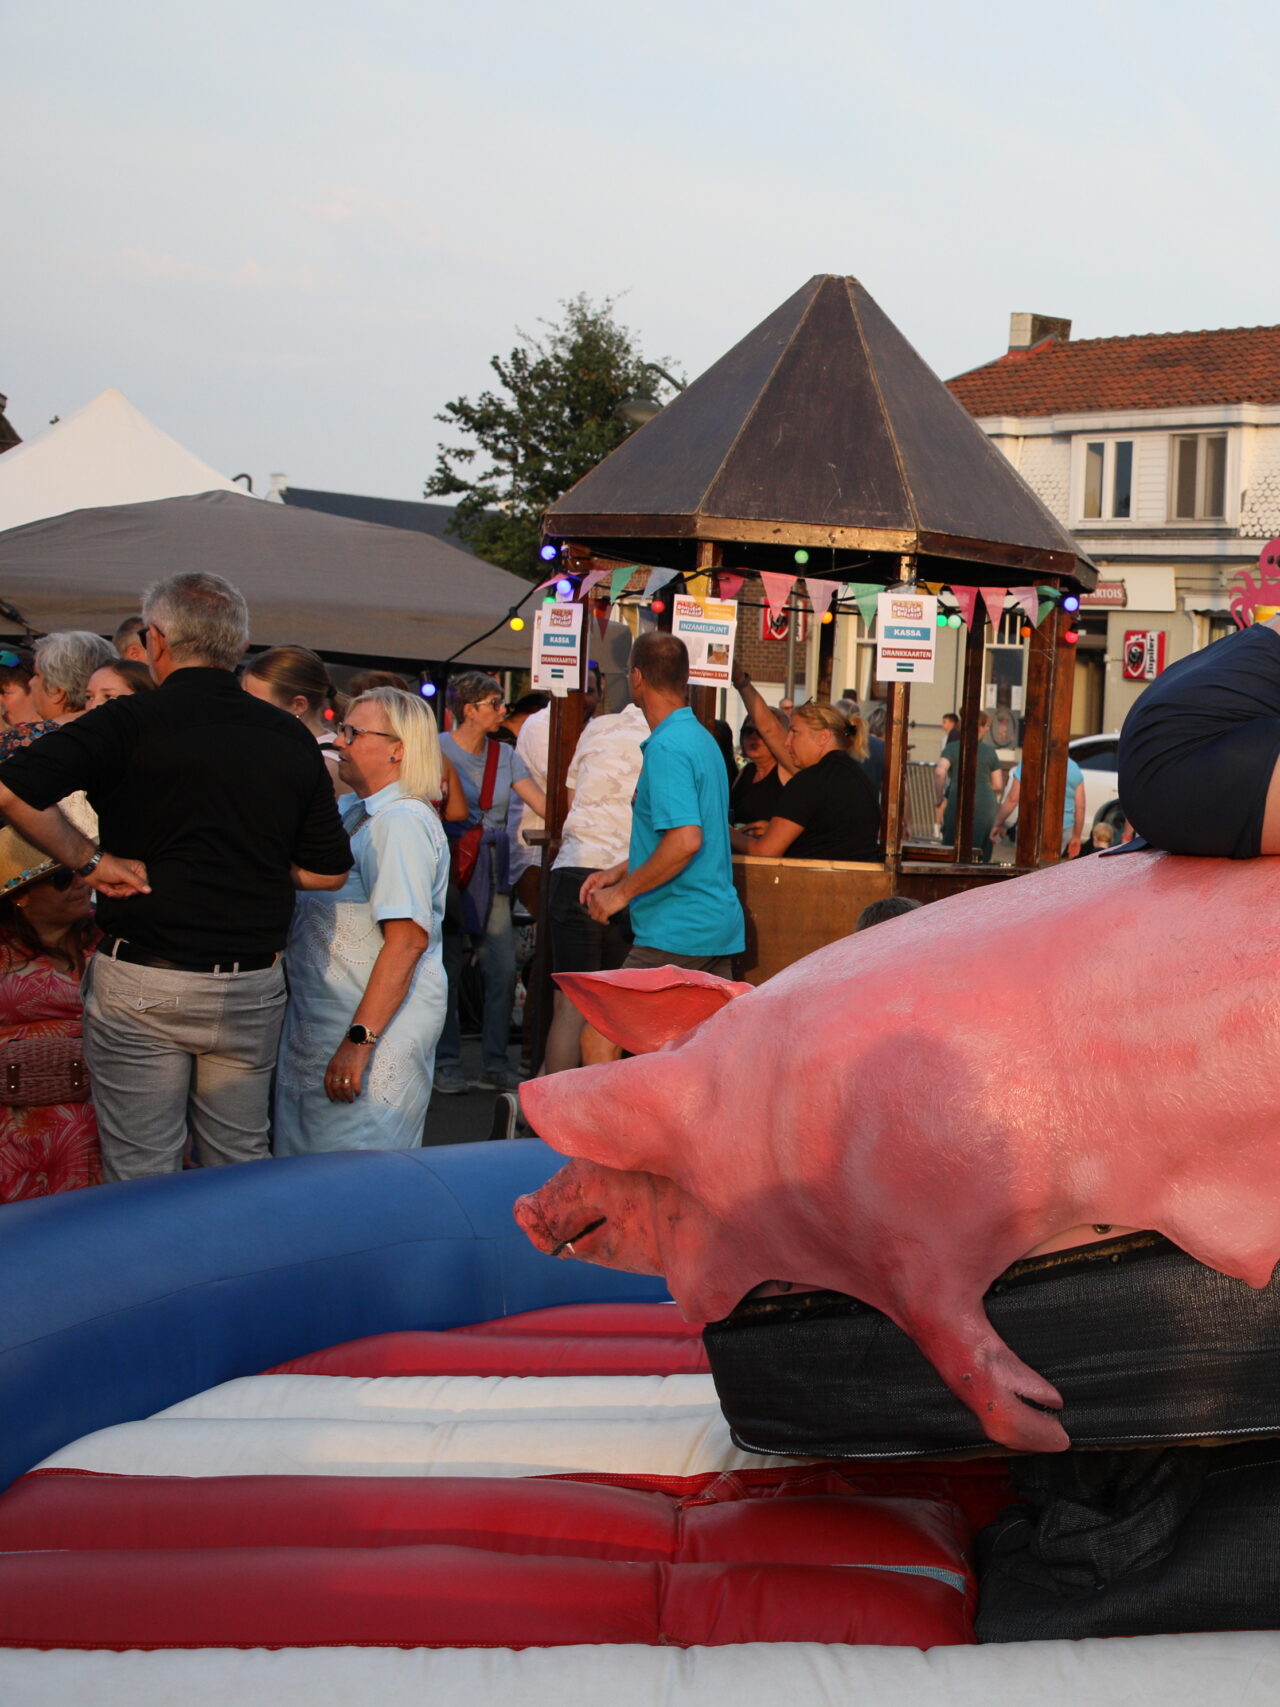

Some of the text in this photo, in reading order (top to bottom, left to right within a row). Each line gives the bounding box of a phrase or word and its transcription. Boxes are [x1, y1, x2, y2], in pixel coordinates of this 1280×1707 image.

[1089, 588, 1122, 599] ARTOIS
[681, 621, 727, 634] INZAMELPUNT
[893, 628, 922, 637] KASSA
[549, 635, 570, 644] KASSA
[882, 649, 931, 658] DRANKKAARTEN
[1147, 635, 1156, 674] Jupiler
[541, 655, 577, 665] DRANKKAARTEN
